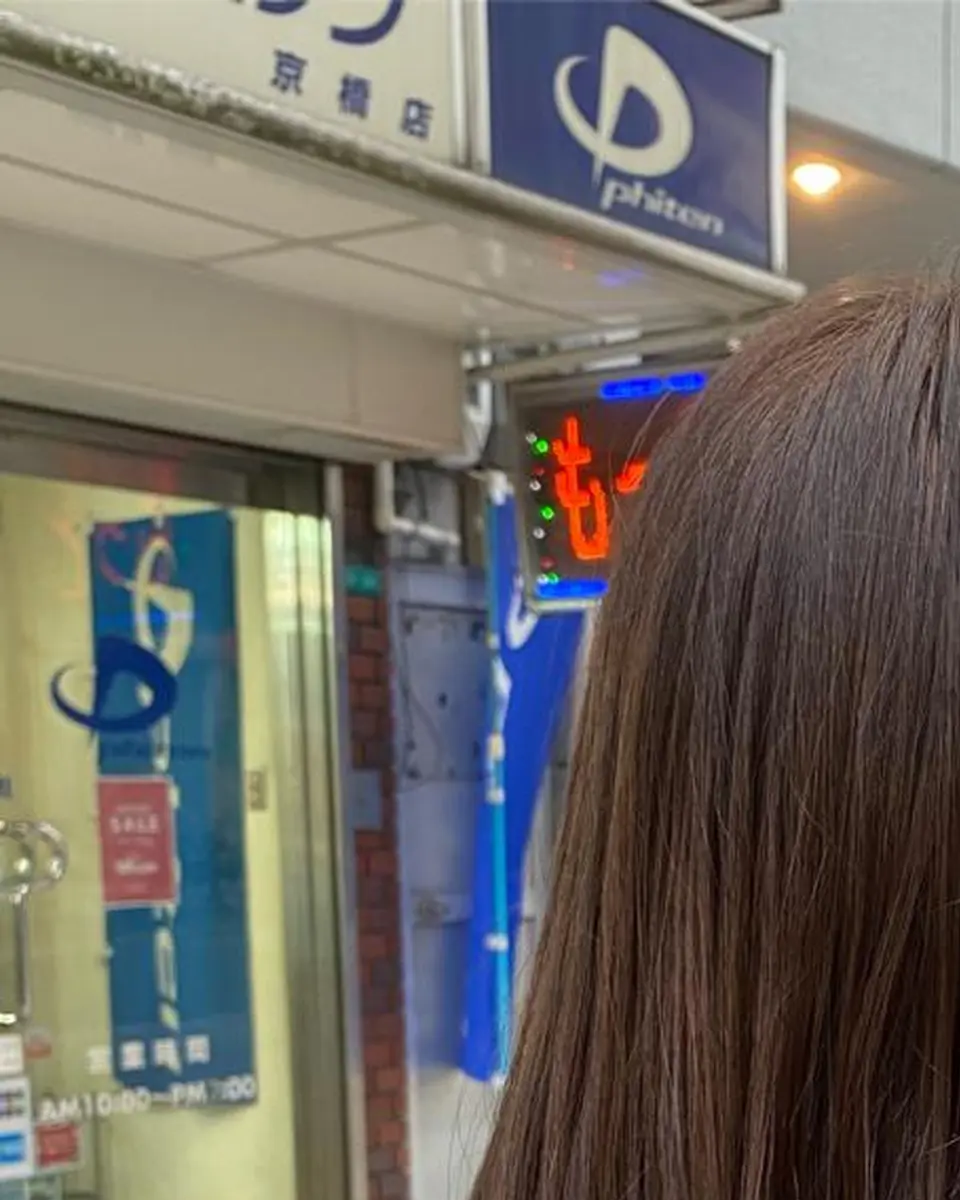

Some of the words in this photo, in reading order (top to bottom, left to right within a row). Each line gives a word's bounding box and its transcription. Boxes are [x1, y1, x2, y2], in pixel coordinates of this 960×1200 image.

[270, 48, 434, 141] 京橋店
[601, 177, 725, 236] phiten
